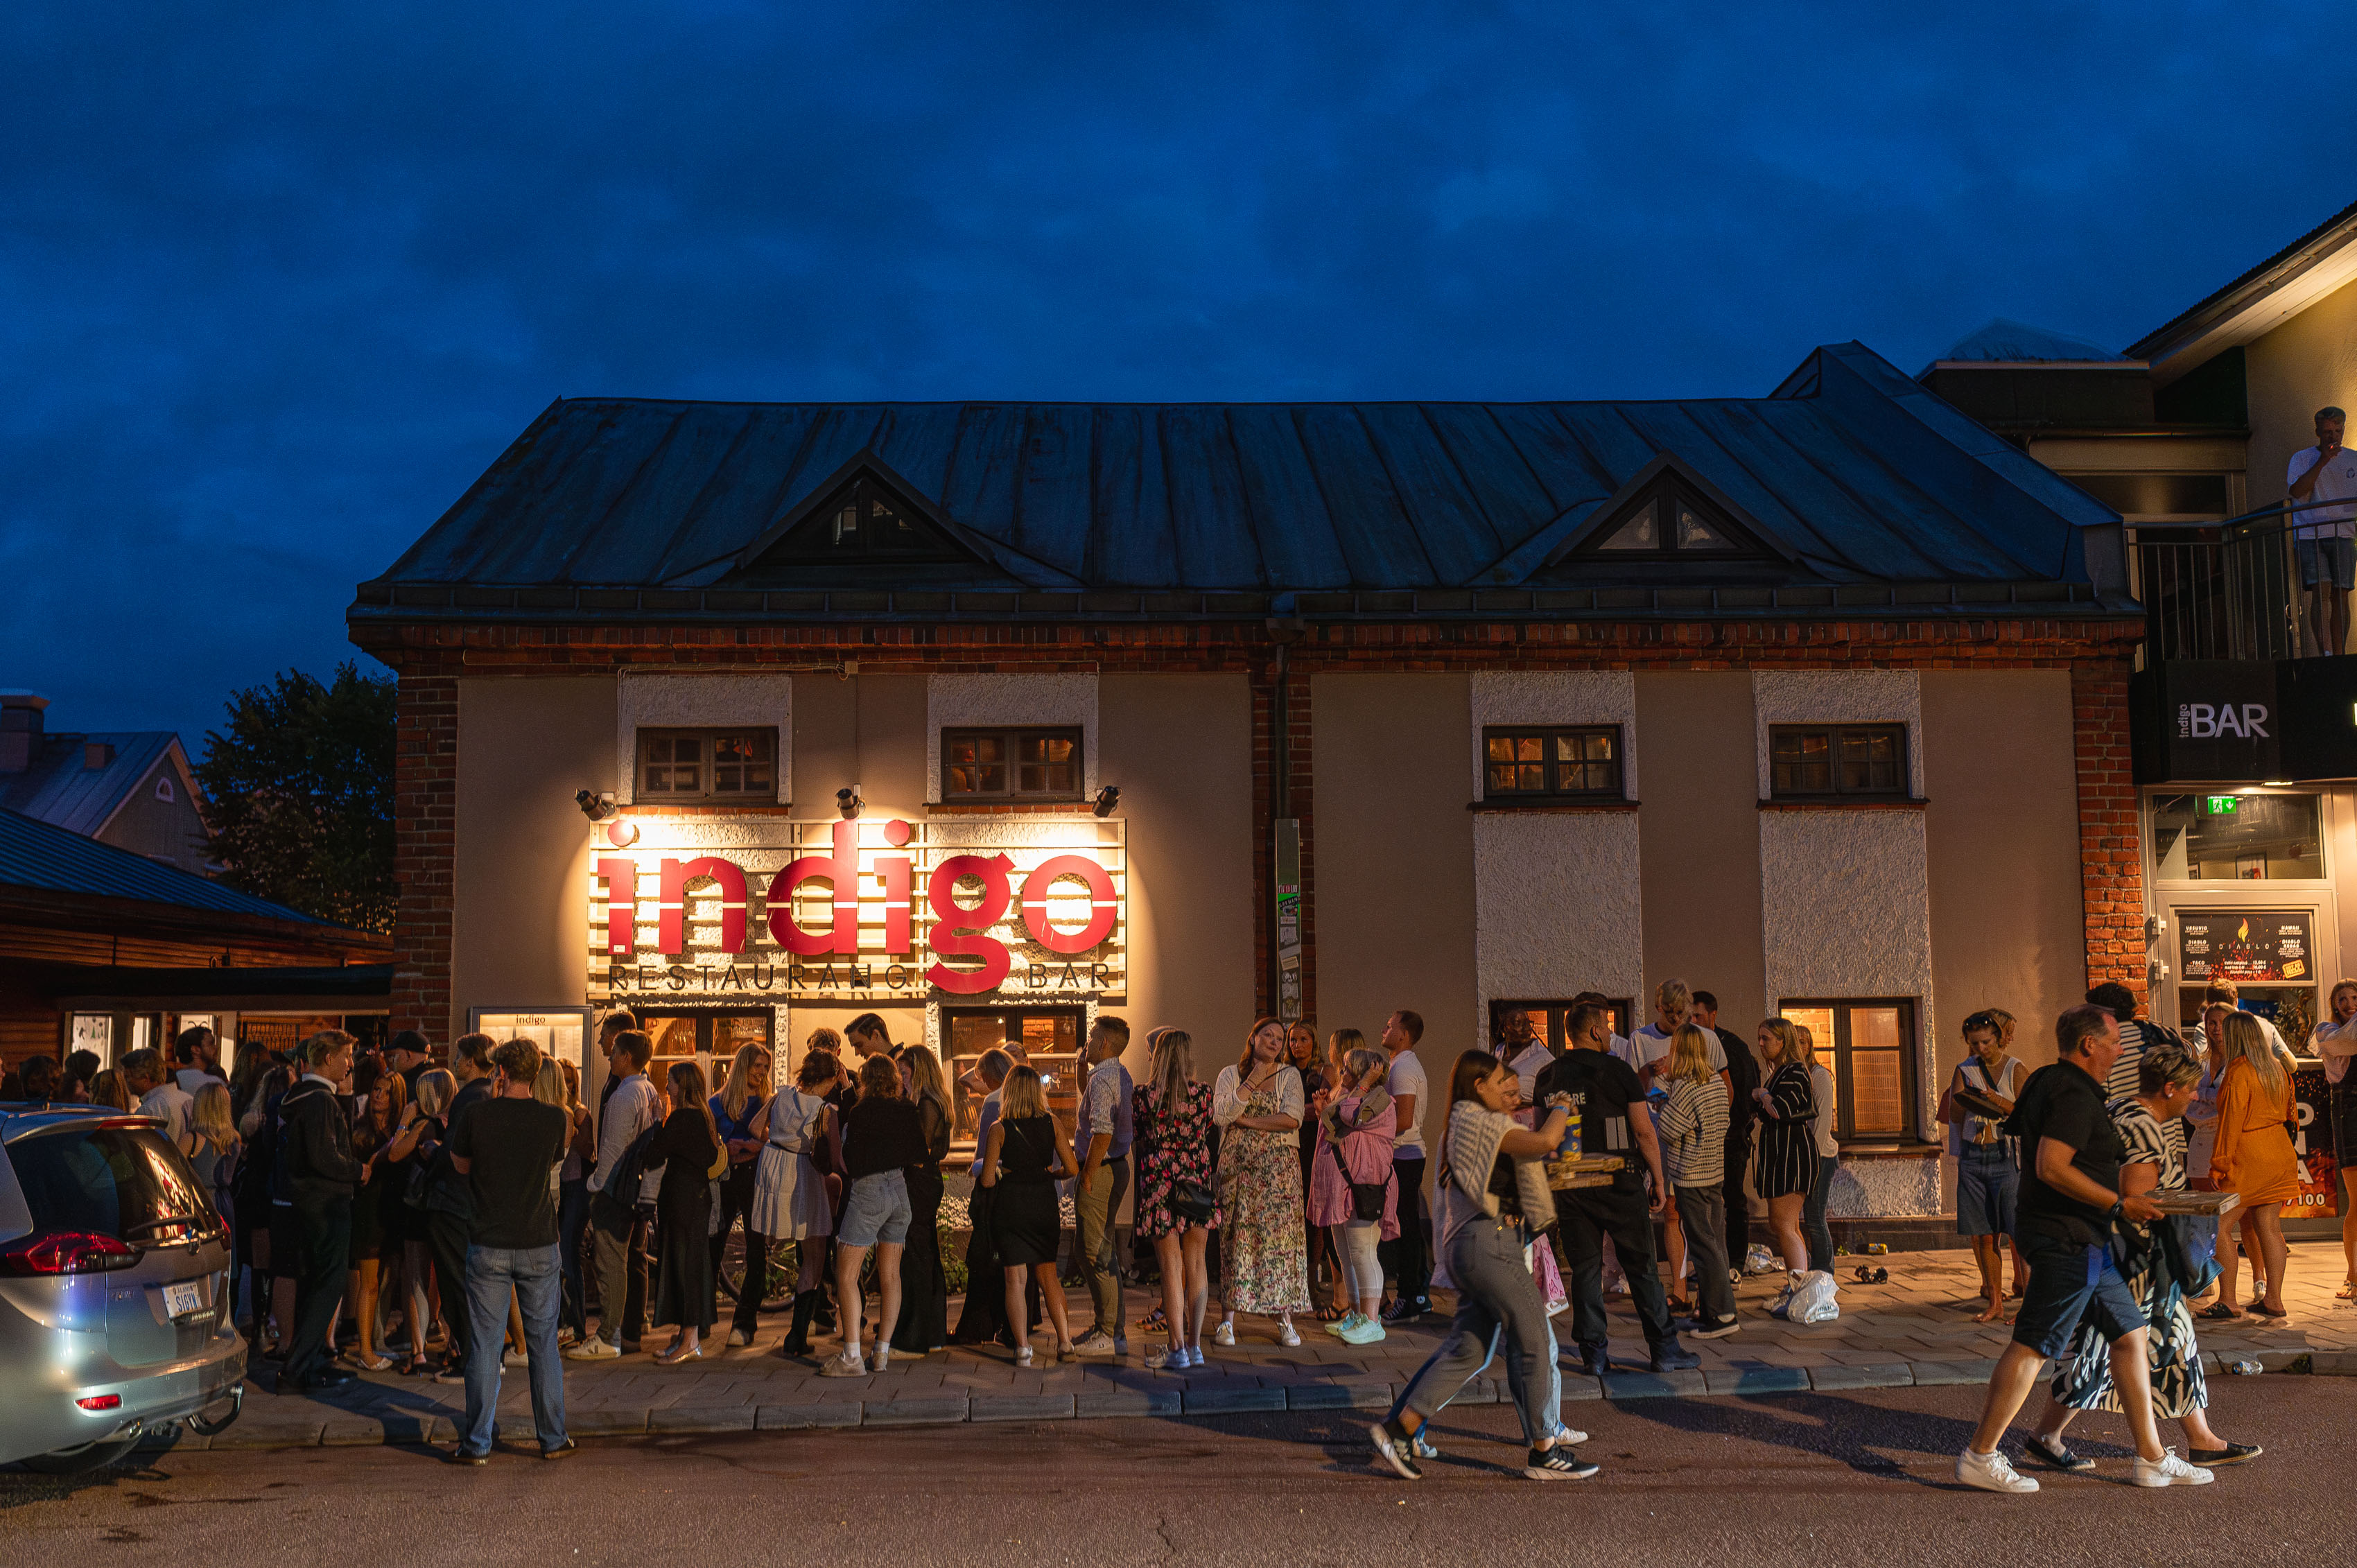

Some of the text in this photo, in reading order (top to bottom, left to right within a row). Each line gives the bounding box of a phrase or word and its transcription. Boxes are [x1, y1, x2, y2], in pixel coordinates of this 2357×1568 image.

[2191, 703, 2270, 738] BAR
[598, 818, 1117, 994] indigo
[608, 963, 1110, 993] RESTAURANG BAR
[516, 1014, 546, 1025] indigo
[176, 1293, 198, 1312] SIGYN
